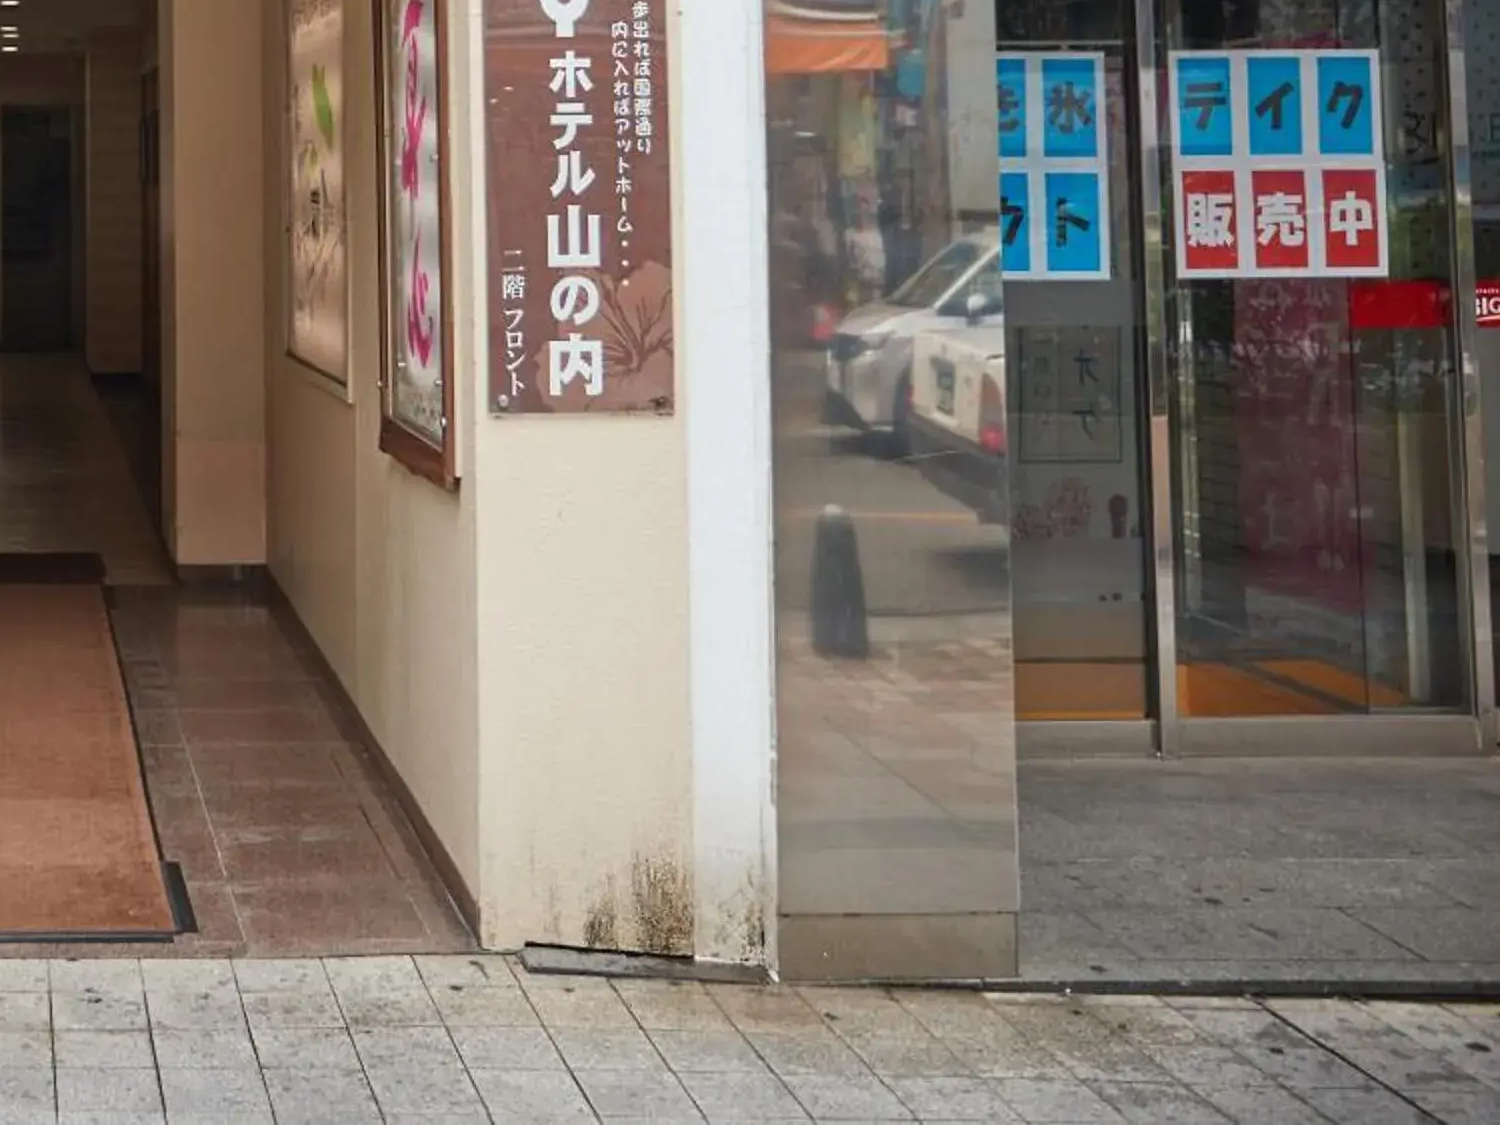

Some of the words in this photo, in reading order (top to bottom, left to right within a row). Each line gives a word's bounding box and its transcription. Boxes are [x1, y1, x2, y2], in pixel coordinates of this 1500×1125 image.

[1185, 81, 1363, 131] テイク
[546, 50, 604, 396] ホテル山の内
[1187, 191, 1374, 247] 販売中
[501, 249, 526, 300] 二階
[503, 308, 527, 395] フロント
